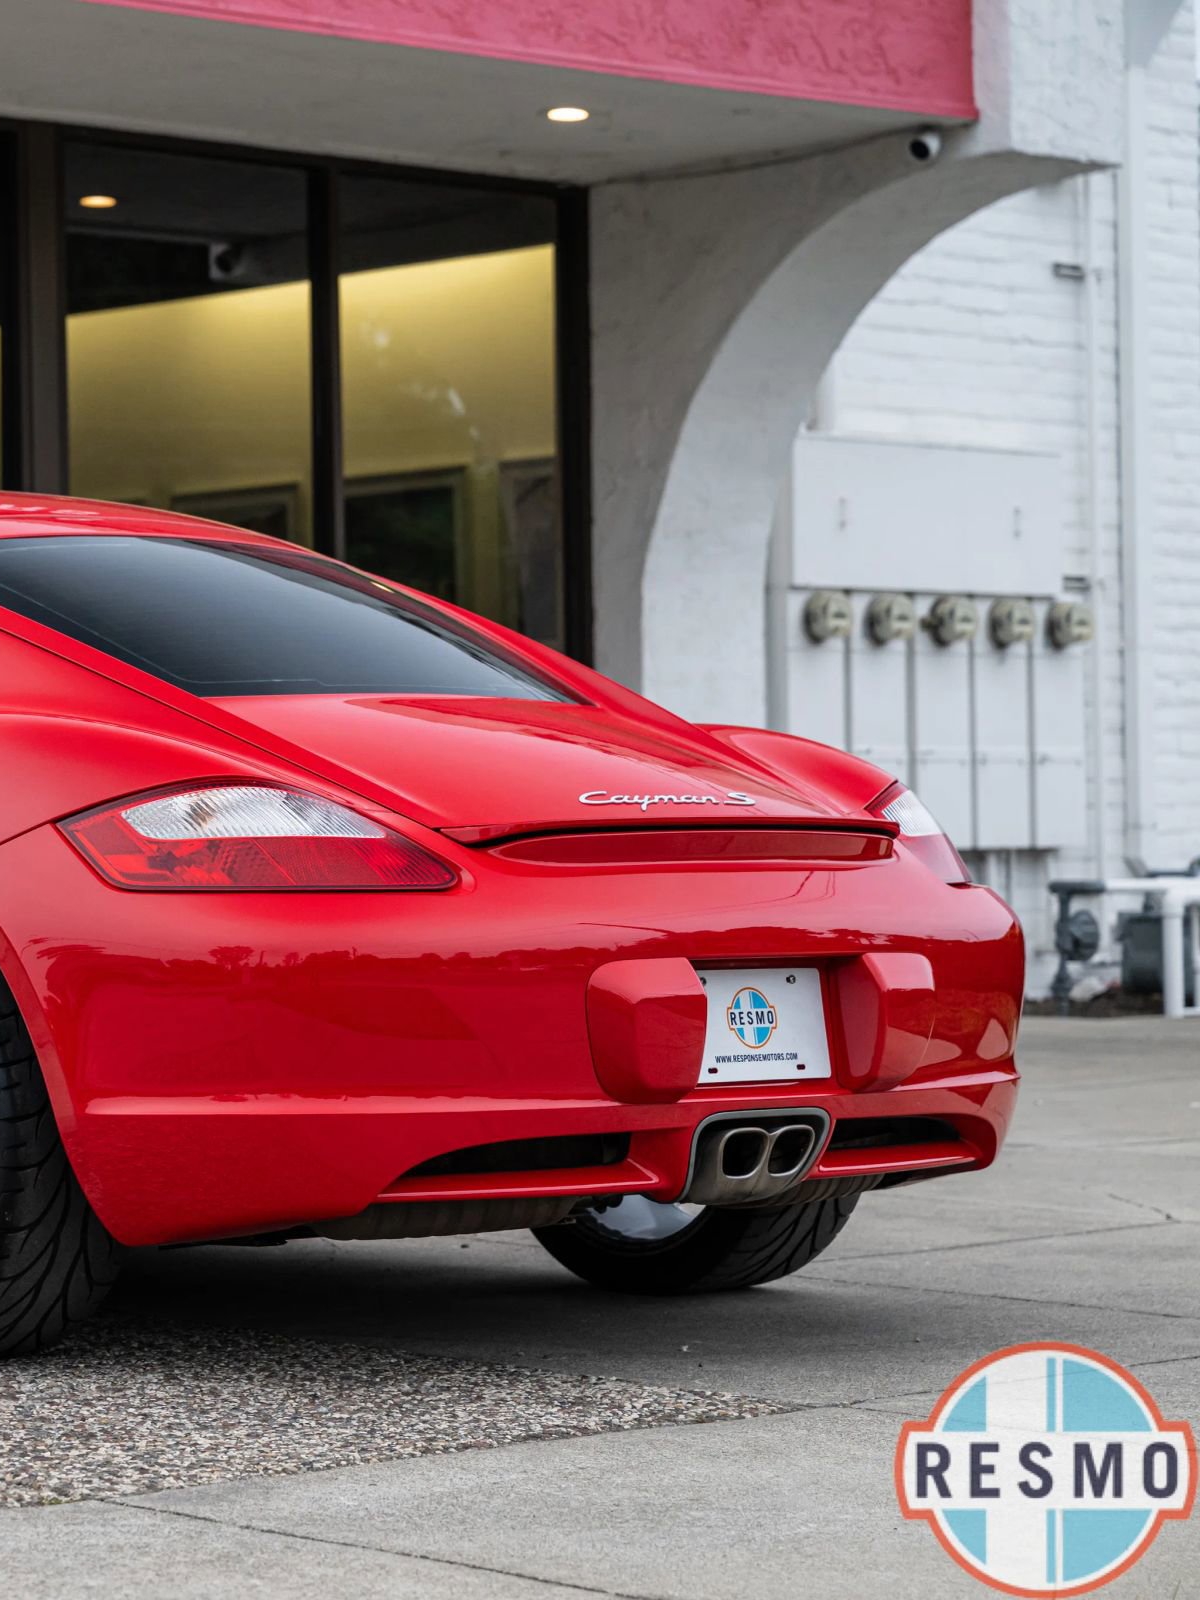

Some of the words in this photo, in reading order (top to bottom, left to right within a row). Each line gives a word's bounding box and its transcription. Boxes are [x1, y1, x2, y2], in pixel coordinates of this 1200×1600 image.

[579, 790, 719, 811] Cayman
[724, 791, 756, 805] S
[729, 1010, 774, 1026] RESMO
[714, 1052, 799, 1064] WWW.RESPONSEMOTORS.COM
